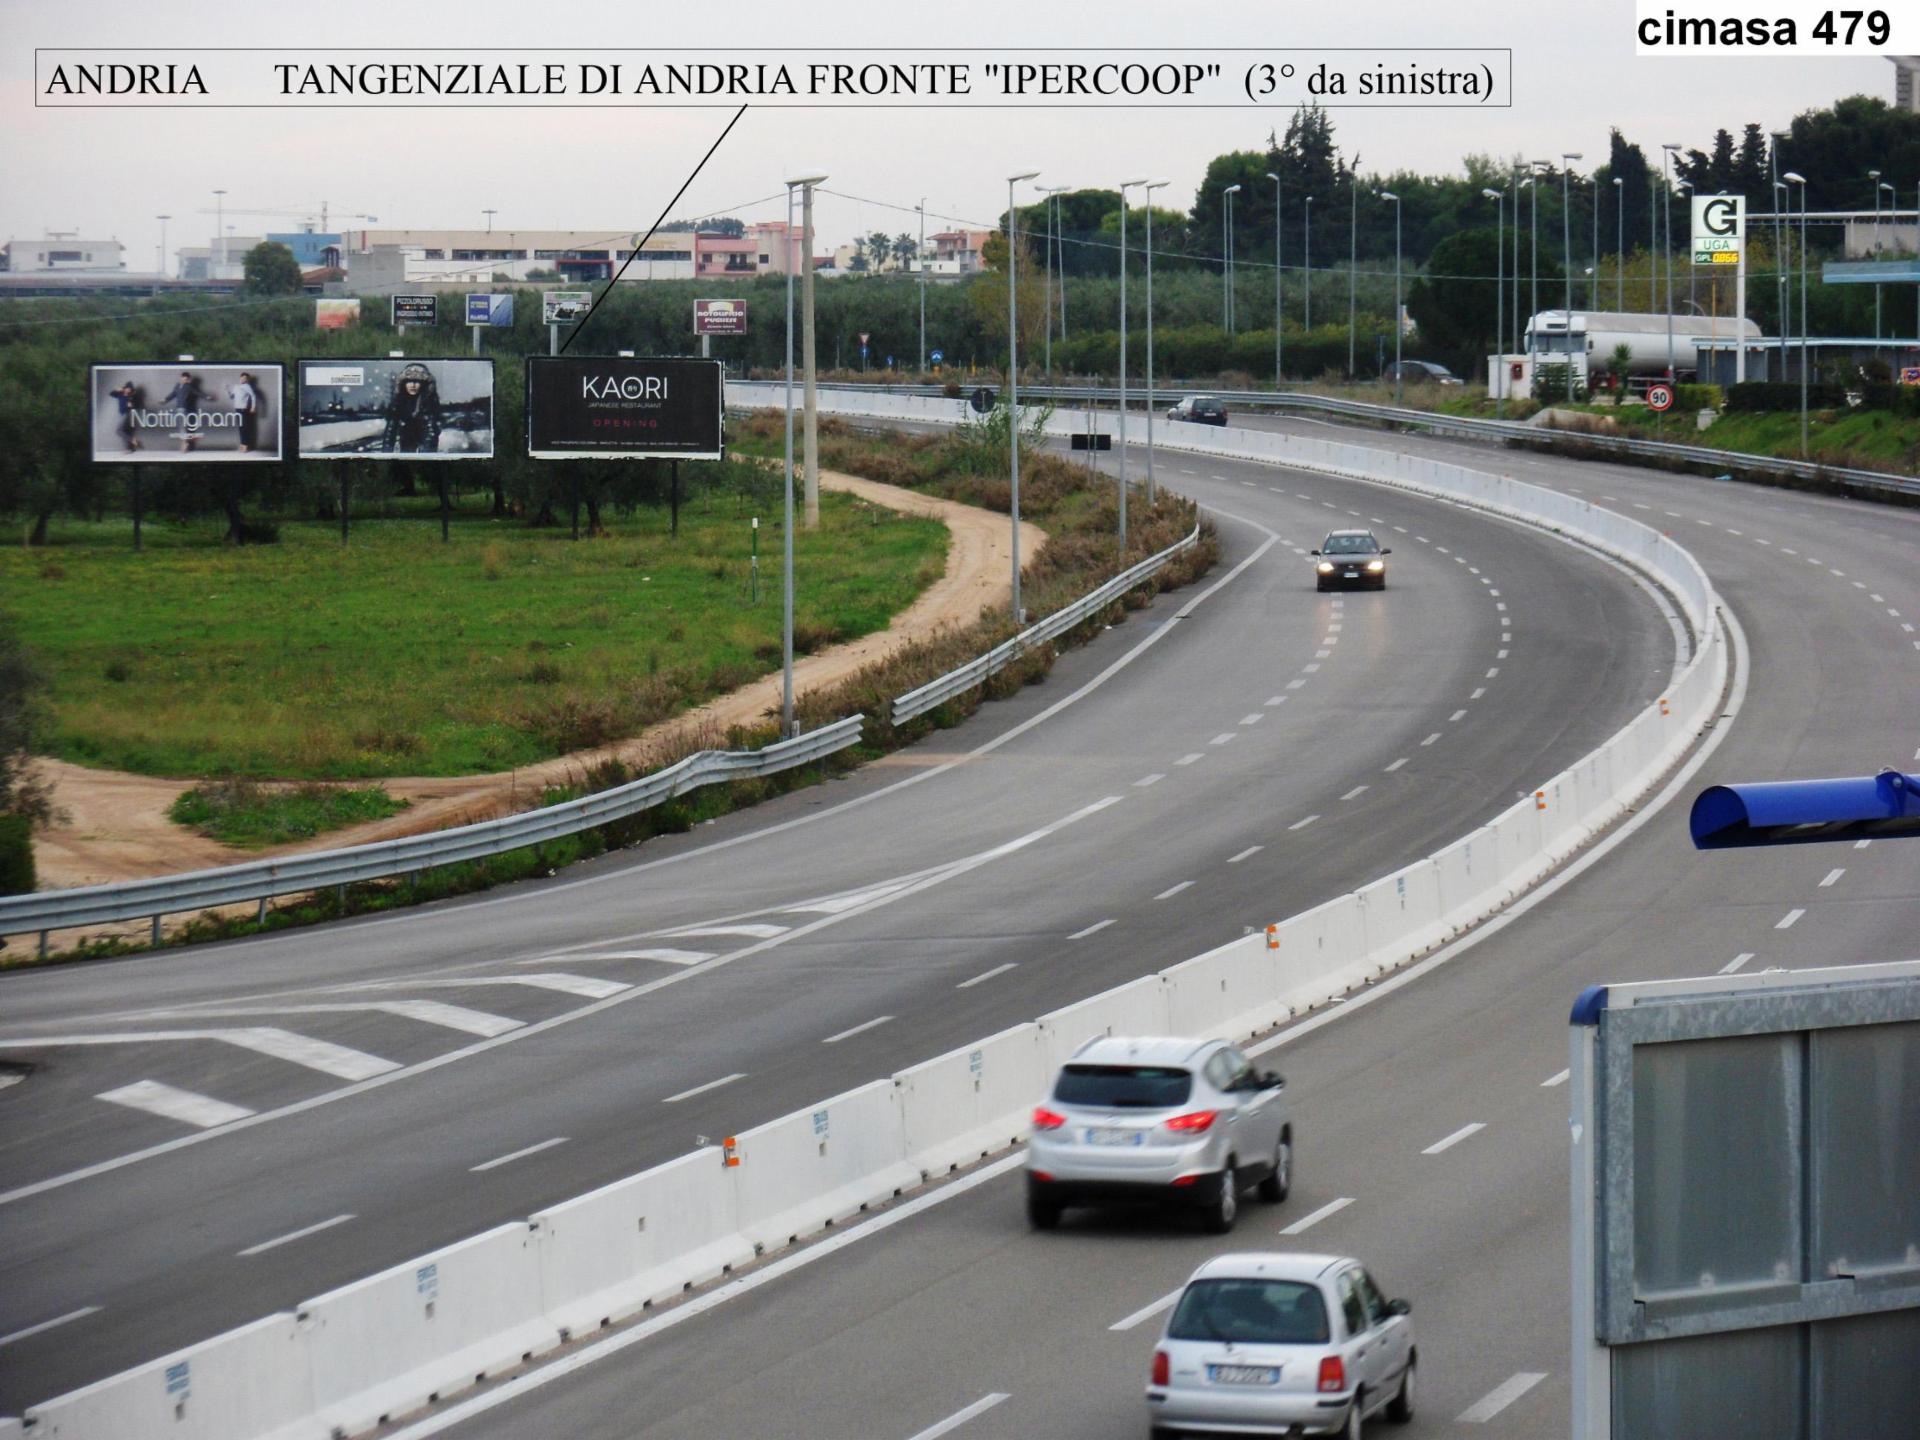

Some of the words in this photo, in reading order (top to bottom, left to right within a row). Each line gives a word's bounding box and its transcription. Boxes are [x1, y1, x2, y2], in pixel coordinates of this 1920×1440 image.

[1703, 240, 1730, 250] UGA
[583, 376, 668, 399] KAORI
[1652, 391, 1667, 404] 90
[130, 408, 243, 431] Nottingham
